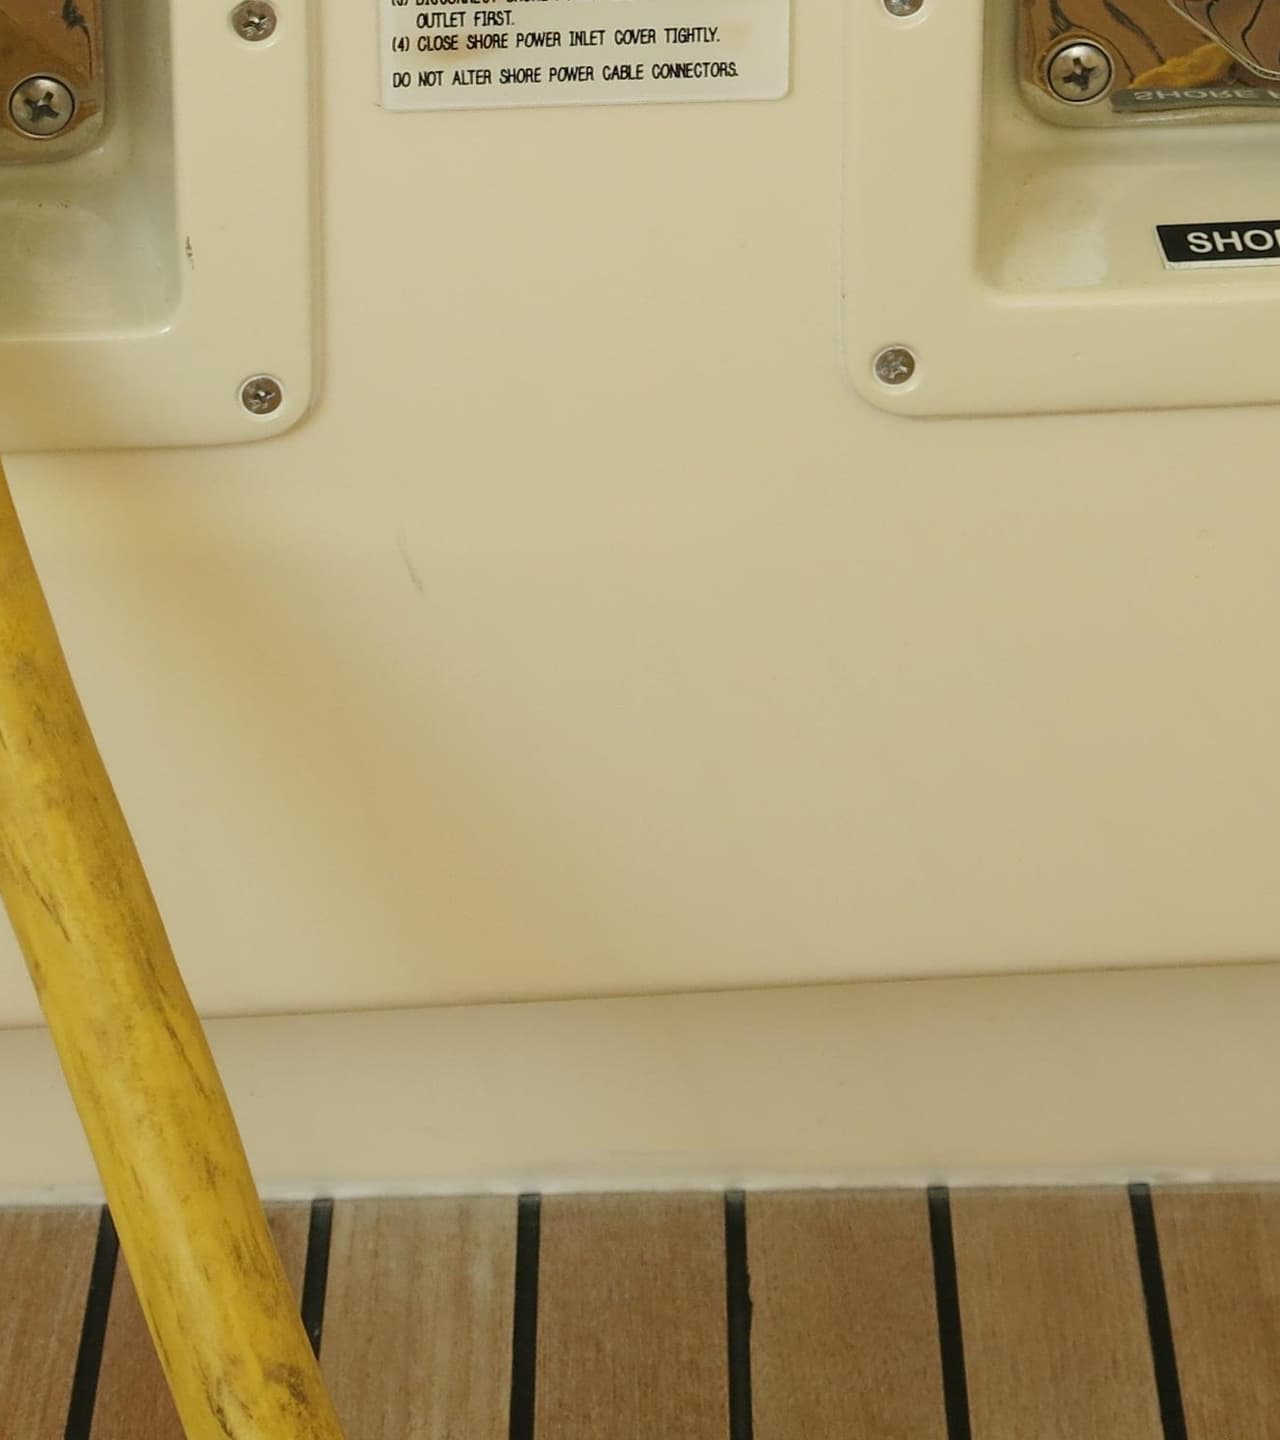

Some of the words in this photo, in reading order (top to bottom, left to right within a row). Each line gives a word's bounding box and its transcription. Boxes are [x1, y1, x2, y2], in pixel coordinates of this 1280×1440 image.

[415, 10, 467, 30] OUTLET
[473, 9, 515, 27] FIRST.
[391, 35, 410, 53] (4)
[416, 33, 459, 53] CLOSE
[465, 32, 509, 51] SHORE
[515, 31, 562, 49] POWER
[568, 29, 607, 47] INLET
[614, 28, 657, 46] COVER
[663, 26, 721, 44] TIGHTLY.
[392, 71, 412, 89] DO
[417, 70, 445, 87] NOT
[451, 68, 493, 86] ALTER
[498, 66, 542, 85] SHORE
[548, 65, 595, 83] POWER
[601, 63, 645, 82] CABLE
[651, 61, 739, 80] CONNECTORS.
